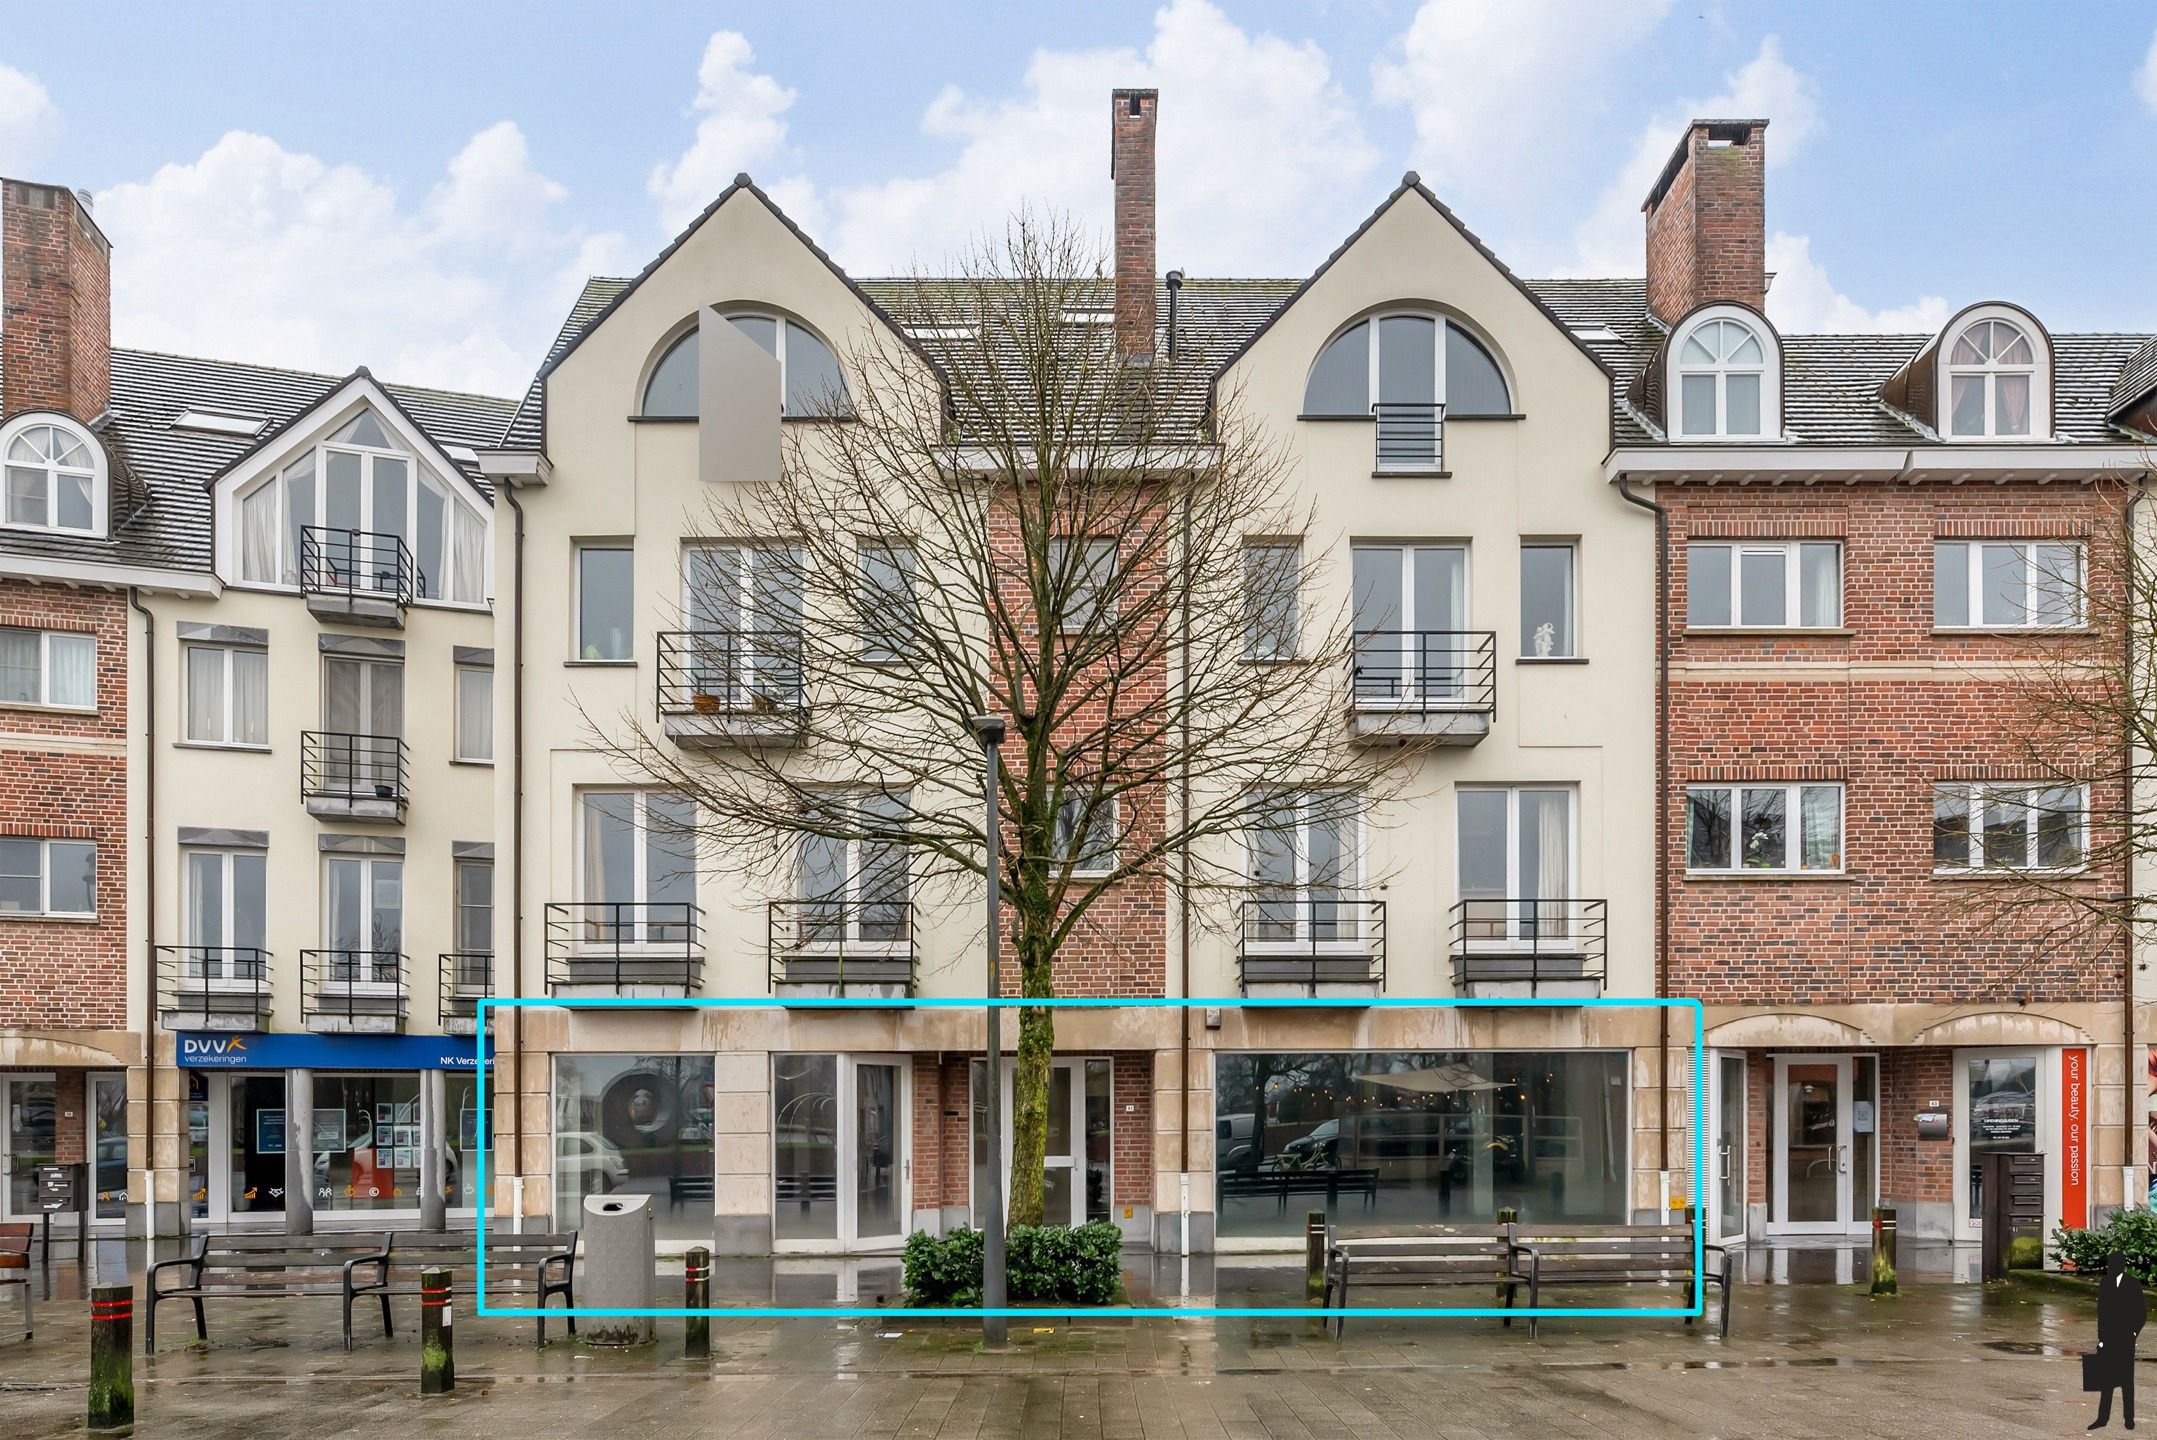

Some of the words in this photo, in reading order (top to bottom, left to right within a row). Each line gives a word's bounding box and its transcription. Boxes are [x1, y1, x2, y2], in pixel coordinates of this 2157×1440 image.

[184, 1039, 227, 1054] DVV
[184, 1054, 247, 1065] verzekeringen
[440, 1056, 455, 1065] NK
[2068, 1055, 2079, 1080] your
[2068, 1084, 2081, 1121] beauty,
[2070, 1125, 2079, 1142] our
[2069, 1146, 2081, 1186] passion
